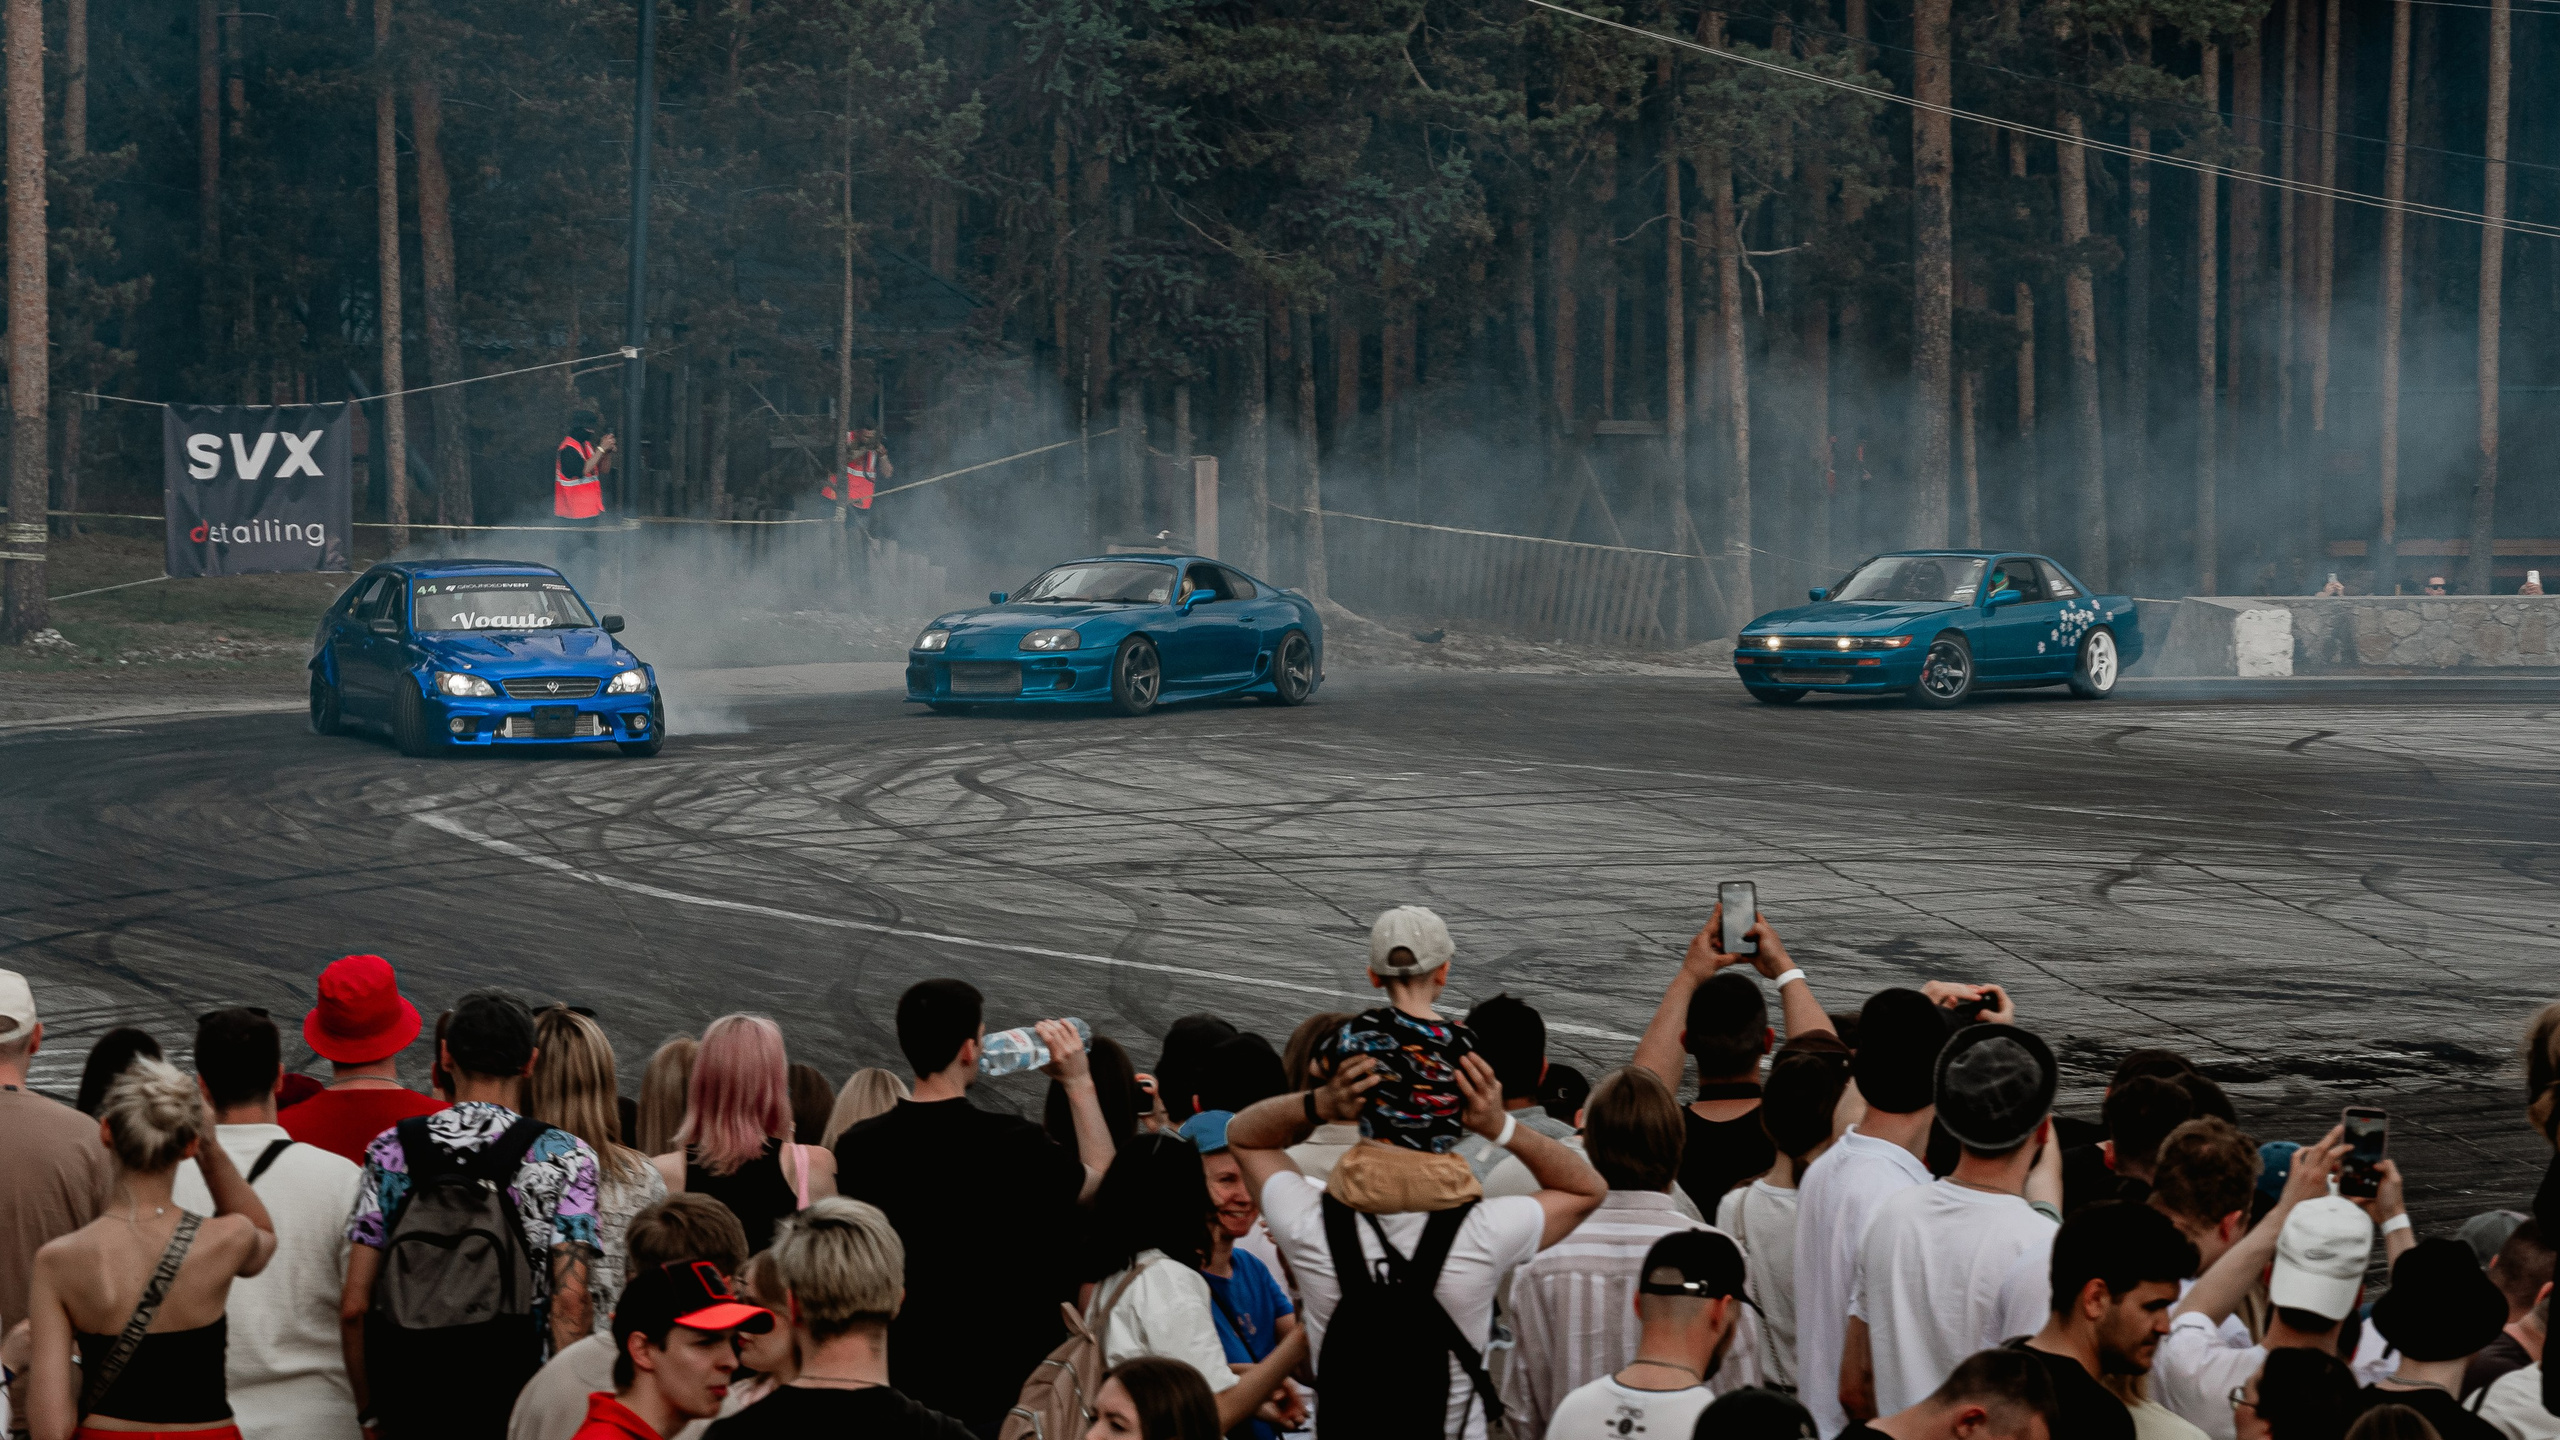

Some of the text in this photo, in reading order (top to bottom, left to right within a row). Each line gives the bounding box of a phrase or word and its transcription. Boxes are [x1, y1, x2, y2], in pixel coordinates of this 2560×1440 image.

[186, 429, 325, 480] SVX
[189, 519, 325, 547] detailing
[416, 584, 438, 595] 44
[451, 611, 554, 629] Voauto
[98, 1305, 153, 1385] MPORIO
[149, 1209, 201, 1291] ARMANI
